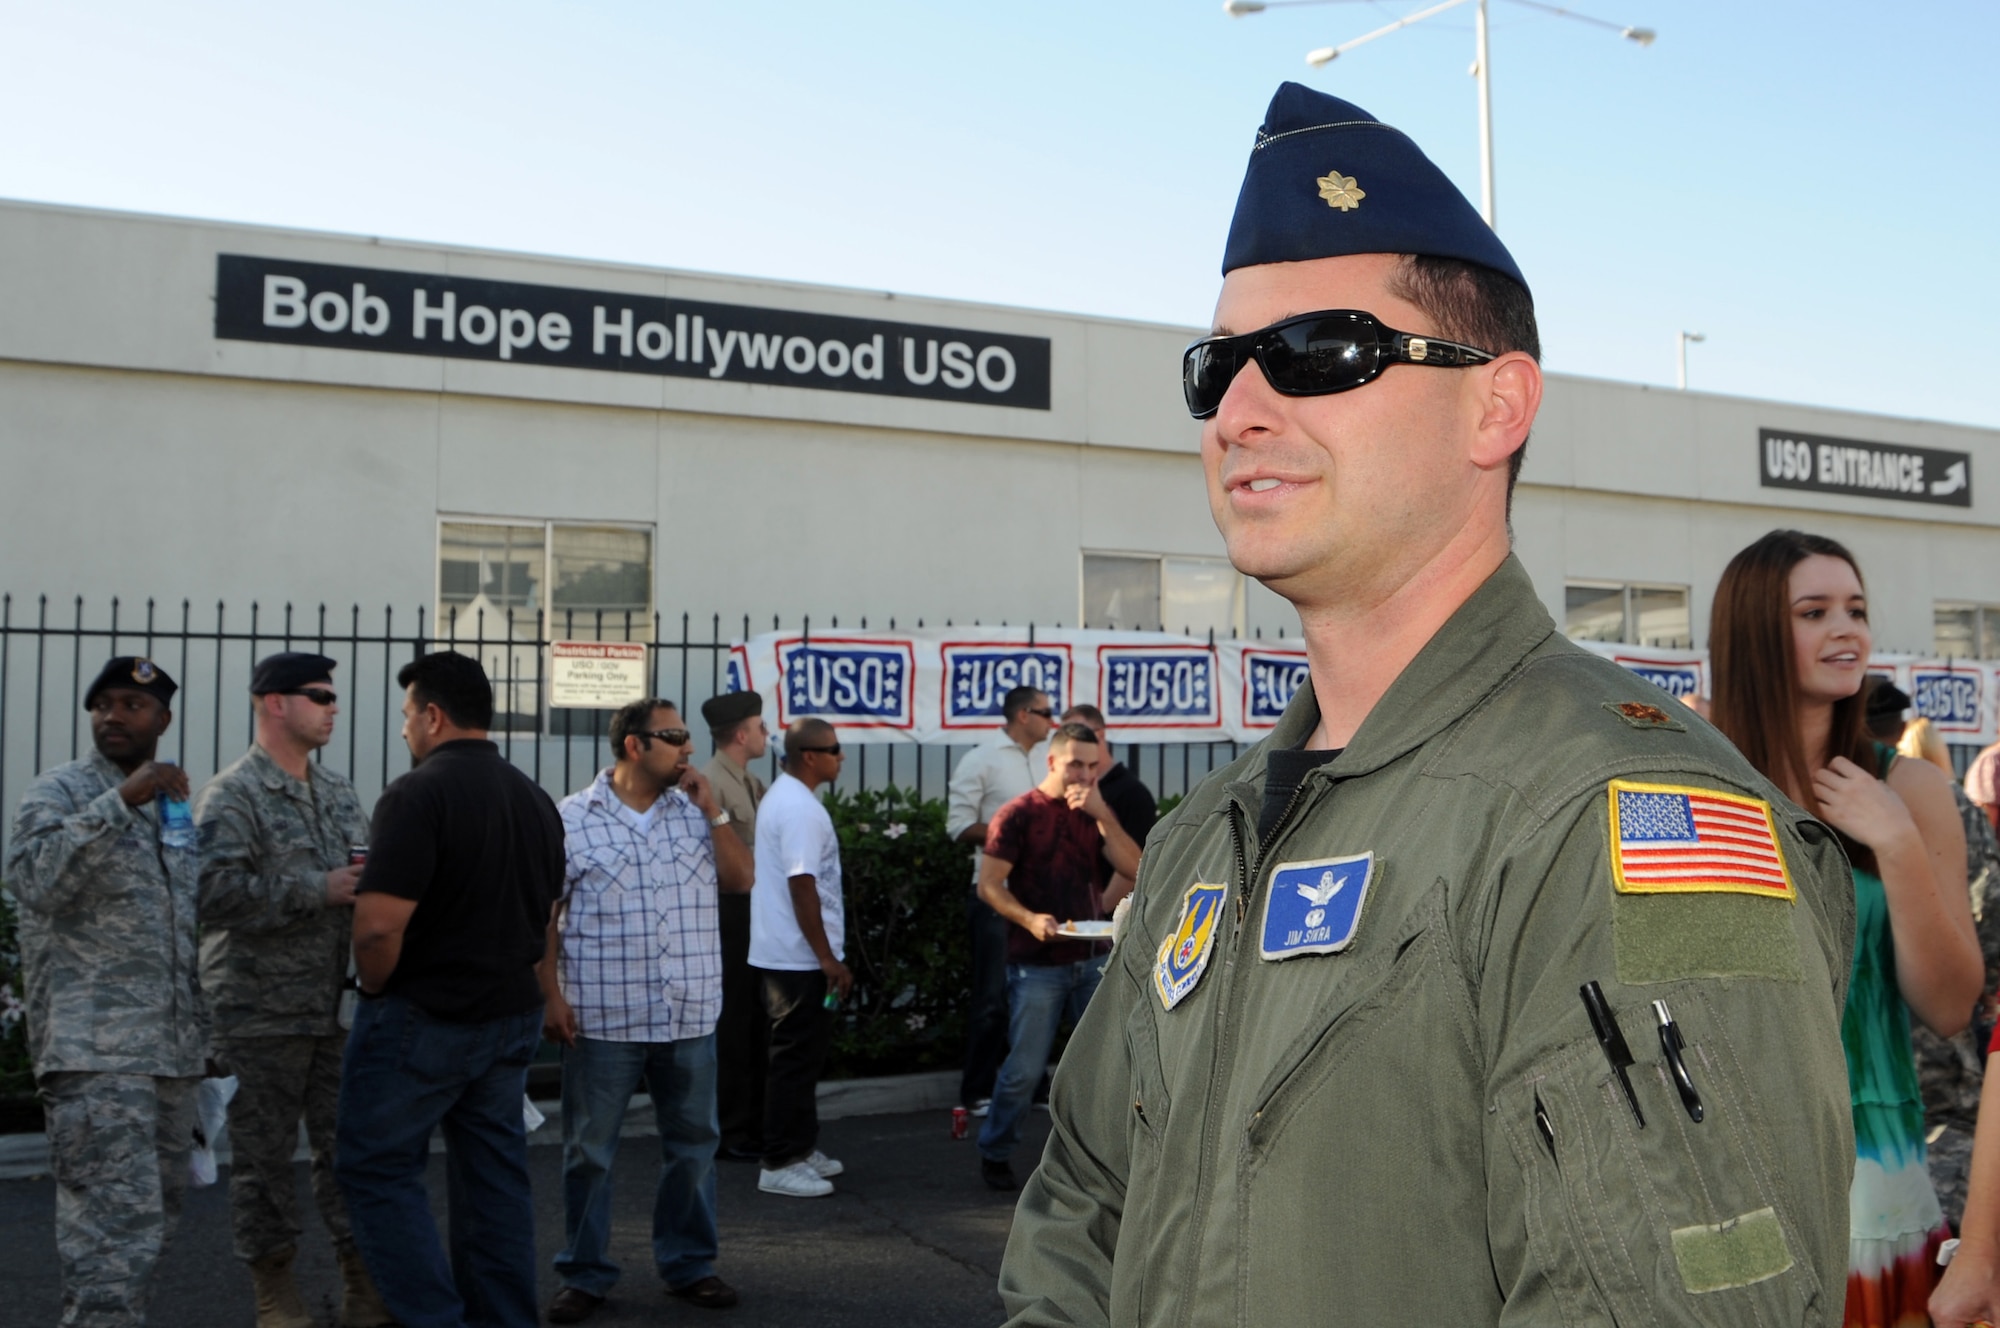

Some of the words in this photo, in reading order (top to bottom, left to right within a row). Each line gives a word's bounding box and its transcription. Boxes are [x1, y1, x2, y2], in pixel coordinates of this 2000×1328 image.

[263, 274, 391, 336] Bob
[412, 288, 573, 361] Hope
[592, 305, 885, 379] Hollywood
[903, 337, 1017, 393] USO
[1765, 437, 1813, 482] USO
[1816, 444, 1926, 495] ENTRANCE
[554, 646, 605, 657] Restricted
[607, 647, 643, 659] Parking
[572, 660, 594, 670] USO
[567, 670, 604, 681] Parking
[606, 671, 628, 682] Only
[806, 654, 884, 710] USO
[1125, 660, 1194, 710] USO
[1266, 665, 1310, 710] US
[1284, 929, 1304, 946] JIM
